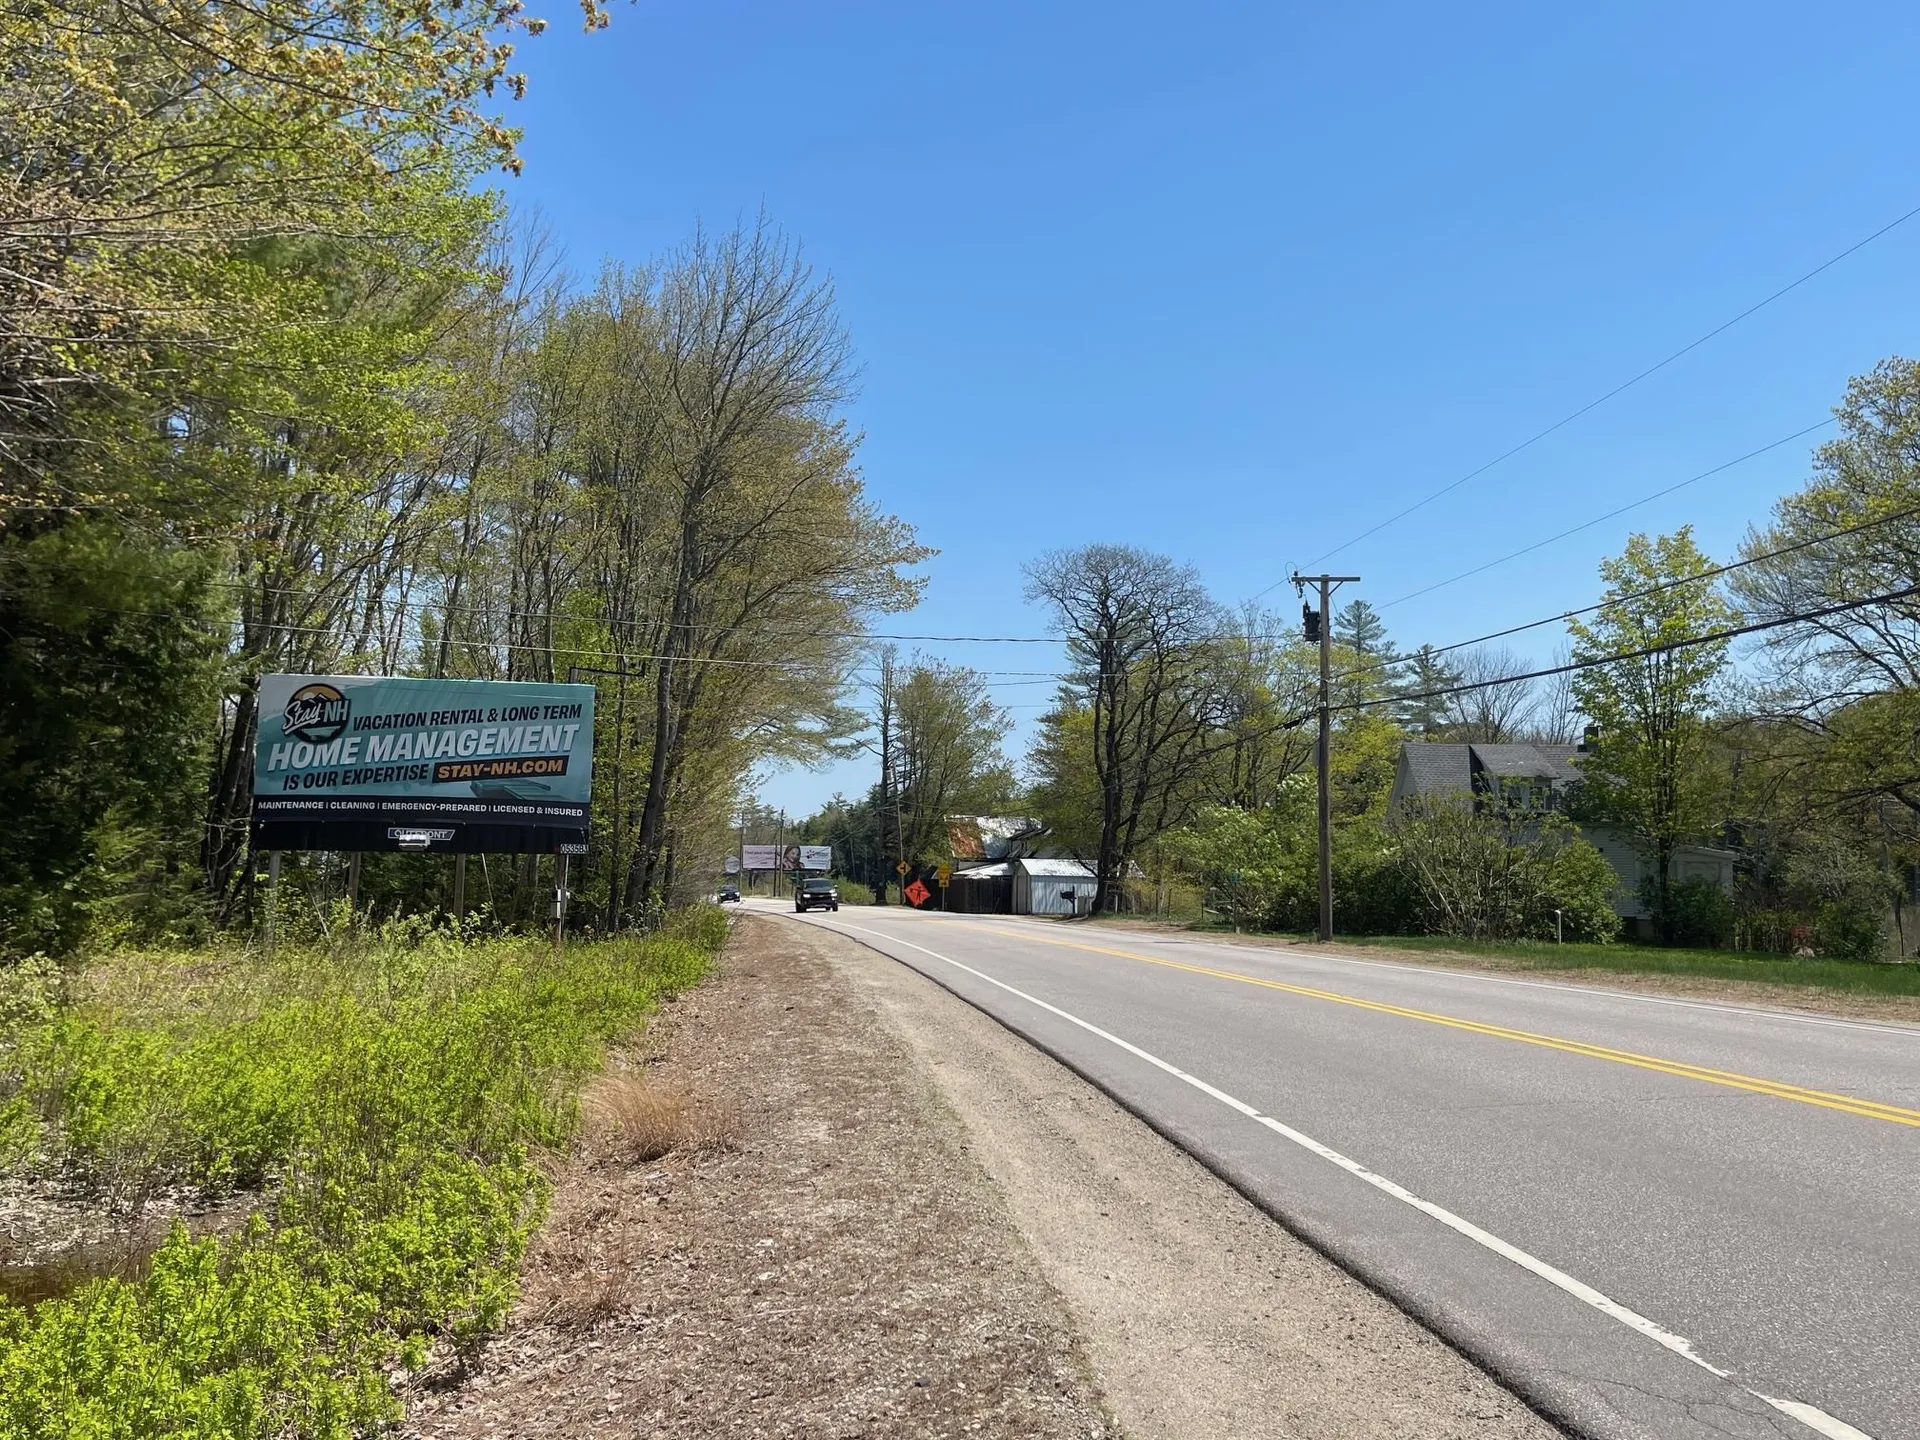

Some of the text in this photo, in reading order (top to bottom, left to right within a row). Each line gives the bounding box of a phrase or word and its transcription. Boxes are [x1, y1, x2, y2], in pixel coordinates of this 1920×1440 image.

[353, 704, 582, 731] VACATION RENTAL & LONG TERM
[268, 724, 580, 771] HOME MANAGEMENT
[283, 759, 563, 791] IS OUR EXPERTISE STAY-NH.COM
[258, 802, 324, 810] MAINTENANCE
[330, 802, 375, 810] CLEANING
[382, 802, 487, 812] EMERGENCY-PREPARED
[493, 805, 535, 814] LICENSED
[544, 807, 583, 817] INSURED
